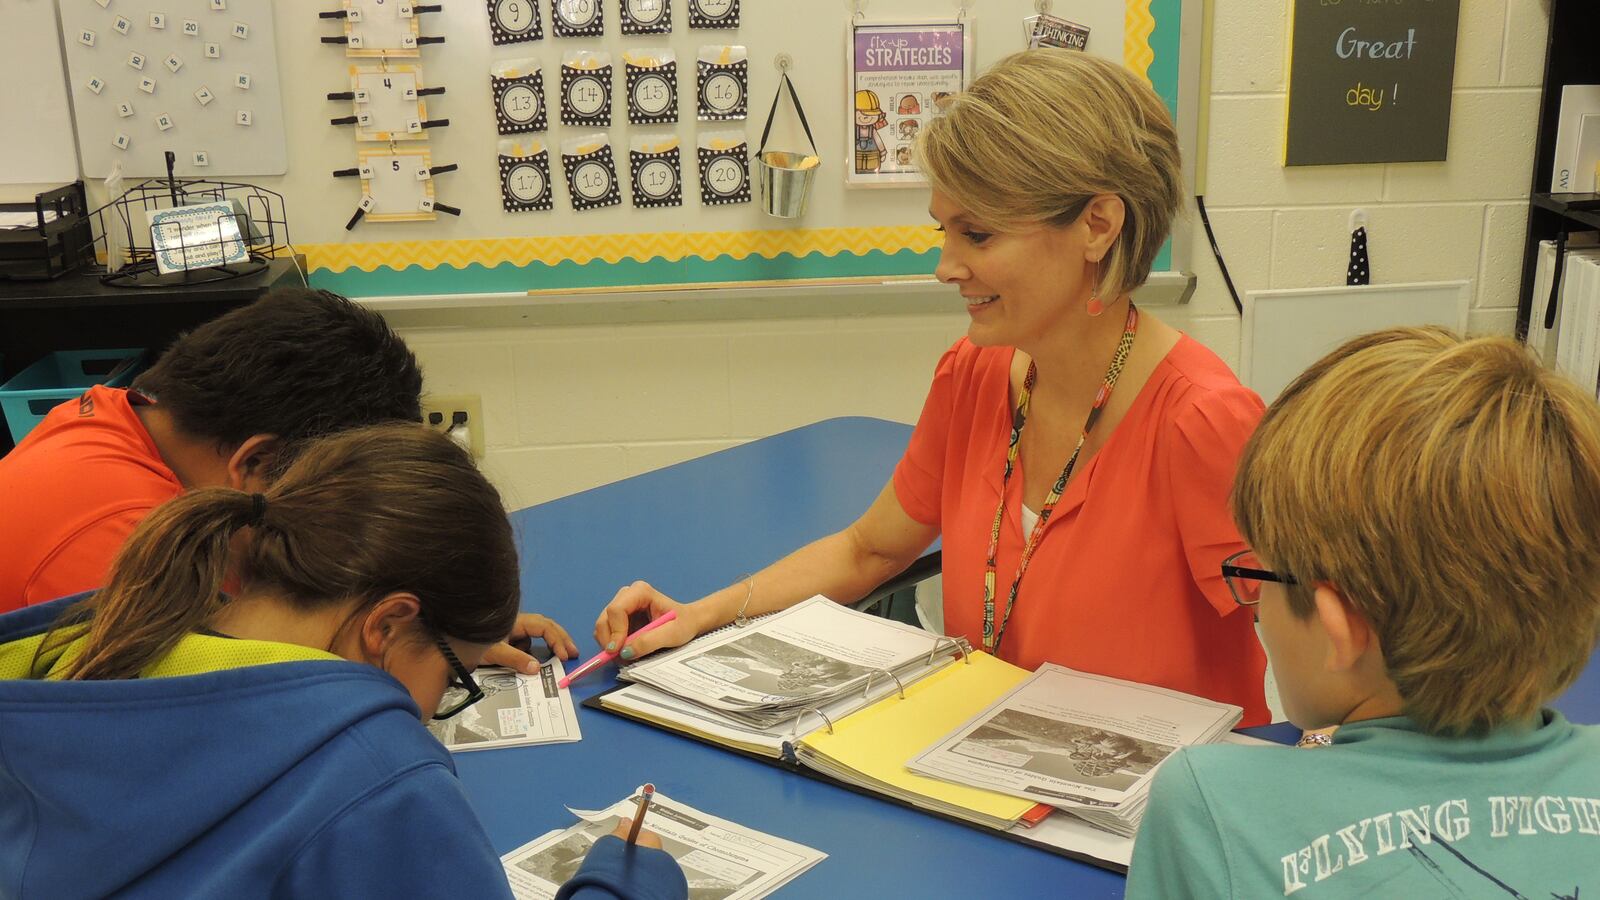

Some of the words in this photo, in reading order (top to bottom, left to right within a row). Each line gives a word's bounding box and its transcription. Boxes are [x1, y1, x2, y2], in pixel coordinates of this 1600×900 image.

[509, 3, 519, 22] 9
[117, 20, 126, 29] 18
[185, 23, 196, 31] 20
[236, 26, 245, 34] 19
[83, 33, 91, 41] 13
[870, 35, 908, 51] fix-up
[1042, 26, 1085, 48] THINKING
[1336, 26, 1417, 59] Great
[209, 46, 215, 54] 8
[866, 47, 952, 66] STRATEGIES
[91, 79, 99, 88] 14
[383, 78, 392, 89] 4
[578, 87, 598, 102] 14
[643, 85, 664, 100] 15
[714, 84, 733, 100] 16
[1346, 82, 1384, 111] day
[511, 96, 531, 112] 13
[159, 118, 169, 126] 12
[242, 113, 247, 121] 2
[196, 154, 204, 162] 16
[392, 160, 400, 171] 5
[583, 172, 603, 189] 18
[649, 171, 667, 186] 19
[716, 167, 736, 182] 20
[517, 175, 537, 190] 17
[1281, 798, 1471, 896] FLYING
